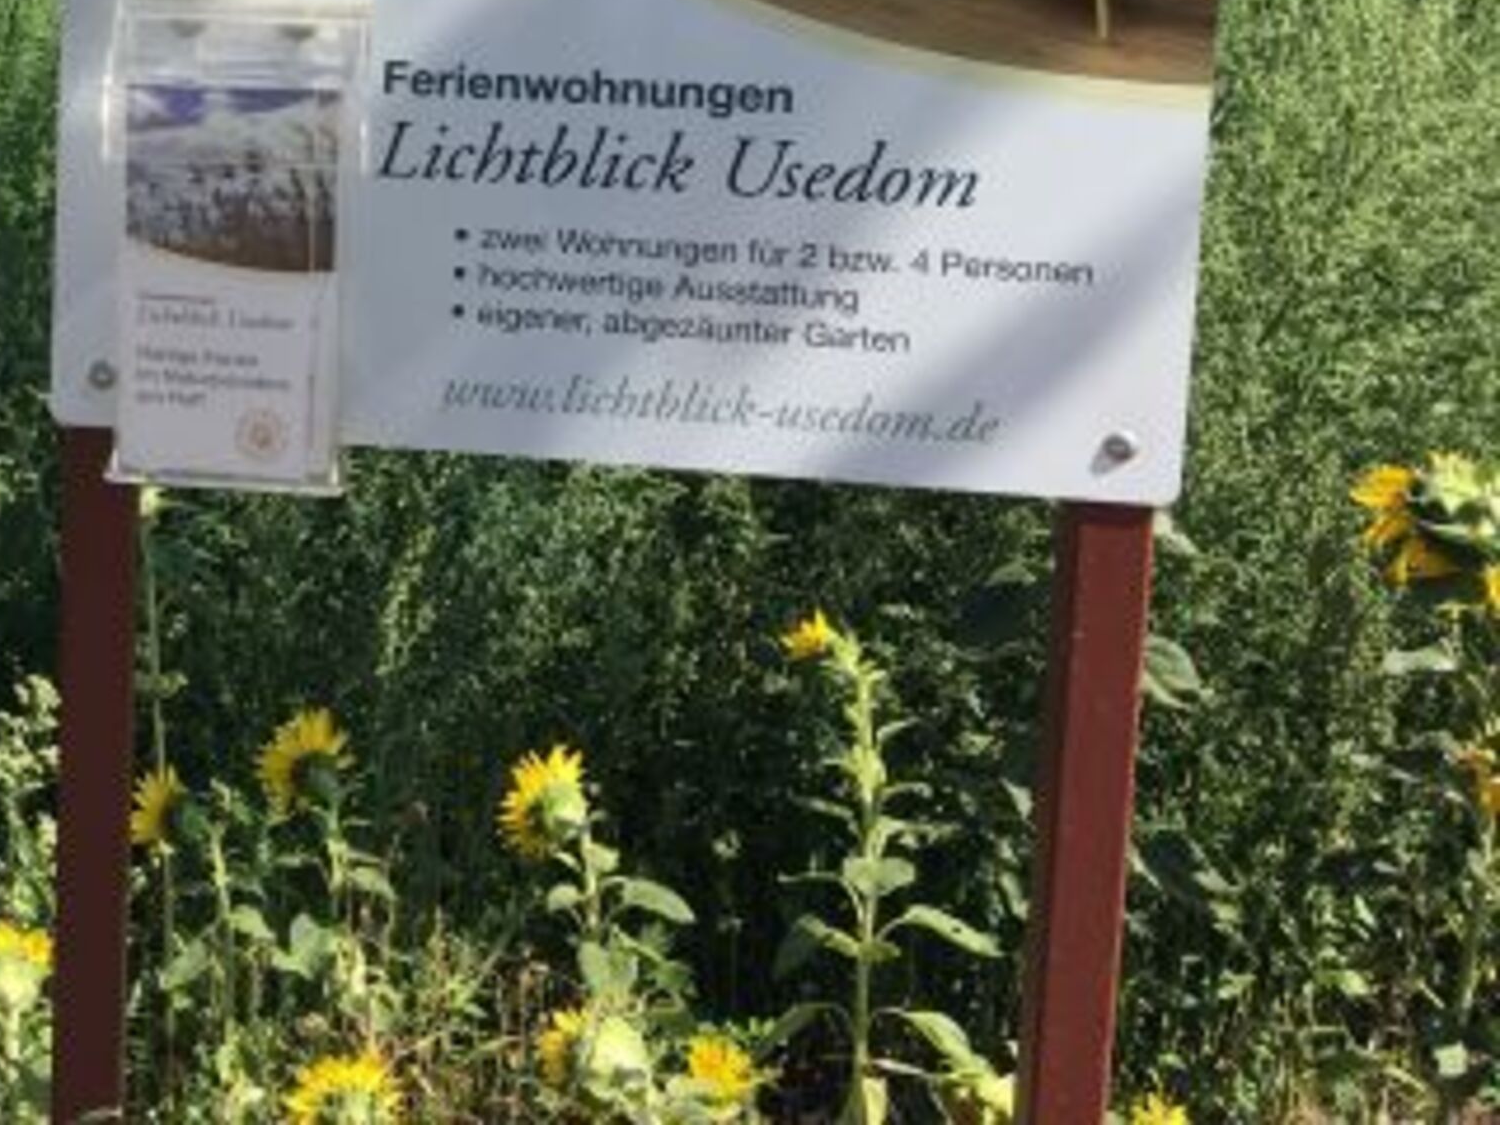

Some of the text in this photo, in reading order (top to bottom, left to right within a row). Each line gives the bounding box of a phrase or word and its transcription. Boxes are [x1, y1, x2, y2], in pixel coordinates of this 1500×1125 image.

[383, 59, 794, 118] Ferienwohnungen
[376, 120, 980, 208] Lichtblick Usedom
[479, 227, 1096, 286] zwei Wohnungen für 2 bzw. 4 Personen
[477, 262, 860, 315] hochwertige Ausstattung
[476, 299, 911, 354] eigener, abgezäunter Garten
[442, 374, 999, 443] www.lichtblick-usedom.de
